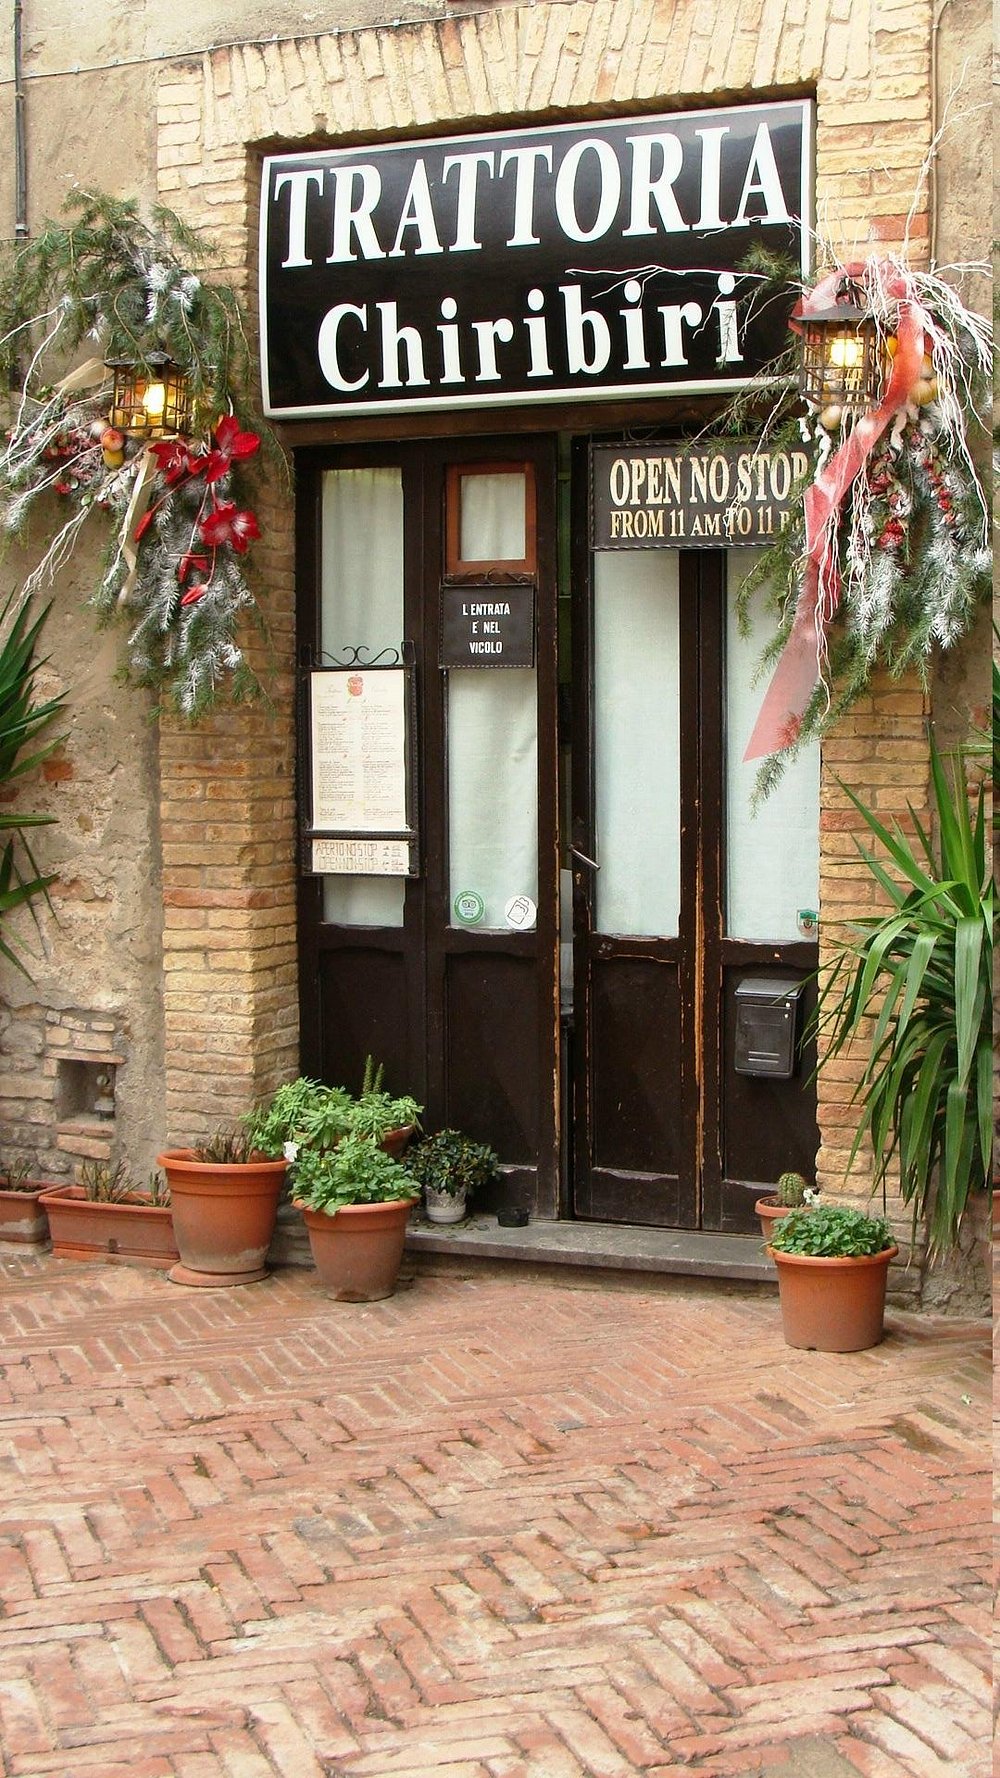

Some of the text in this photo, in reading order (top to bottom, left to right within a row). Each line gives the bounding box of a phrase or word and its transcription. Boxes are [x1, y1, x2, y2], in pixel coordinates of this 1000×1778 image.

[275, 122, 790, 268] TRATTORIA
[317, 274, 744, 392] Chiribiri
[609, 452, 809, 506] OPEN NO STOP
[609, 510, 665, 538] FROM
[669, 508, 686, 537] 11
[690, 513, 721, 537] AM
[726, 506, 753, 536] TO
[757, 506, 774, 534] 11
[469, 641, 503, 654] VICOLO
[483, 621, 501, 634] NEL
